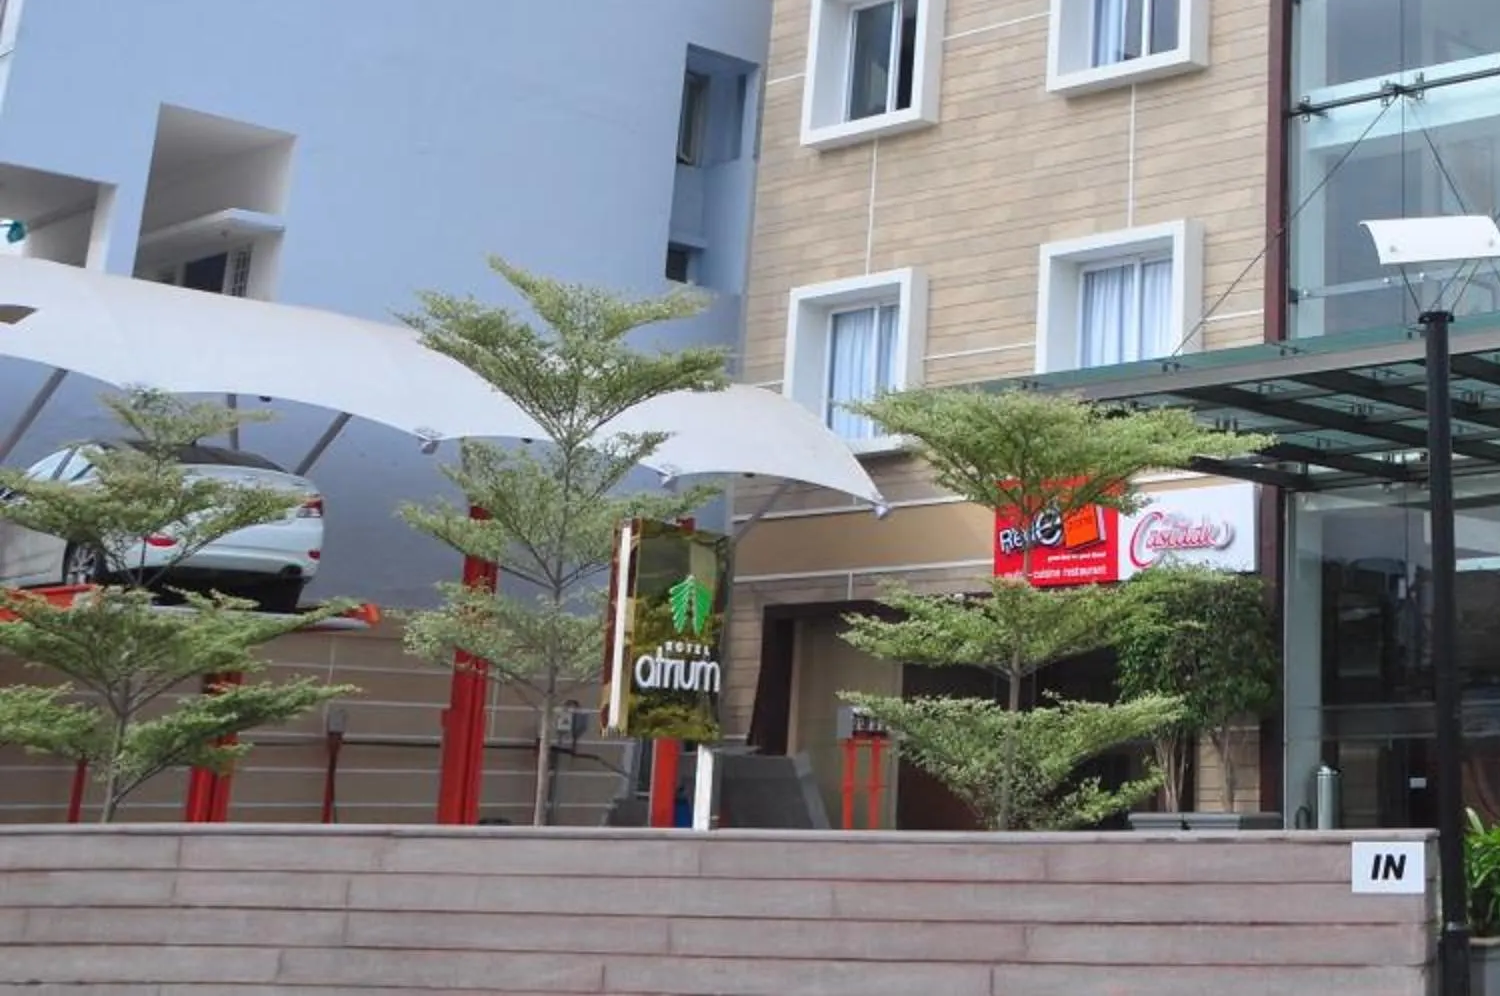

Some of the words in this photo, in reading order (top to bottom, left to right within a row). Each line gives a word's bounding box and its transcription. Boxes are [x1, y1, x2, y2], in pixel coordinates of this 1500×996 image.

[664, 641, 710, 656] HOTEL
[635, 646, 721, 692] atrium
[1371, 853, 1407, 880] IN
